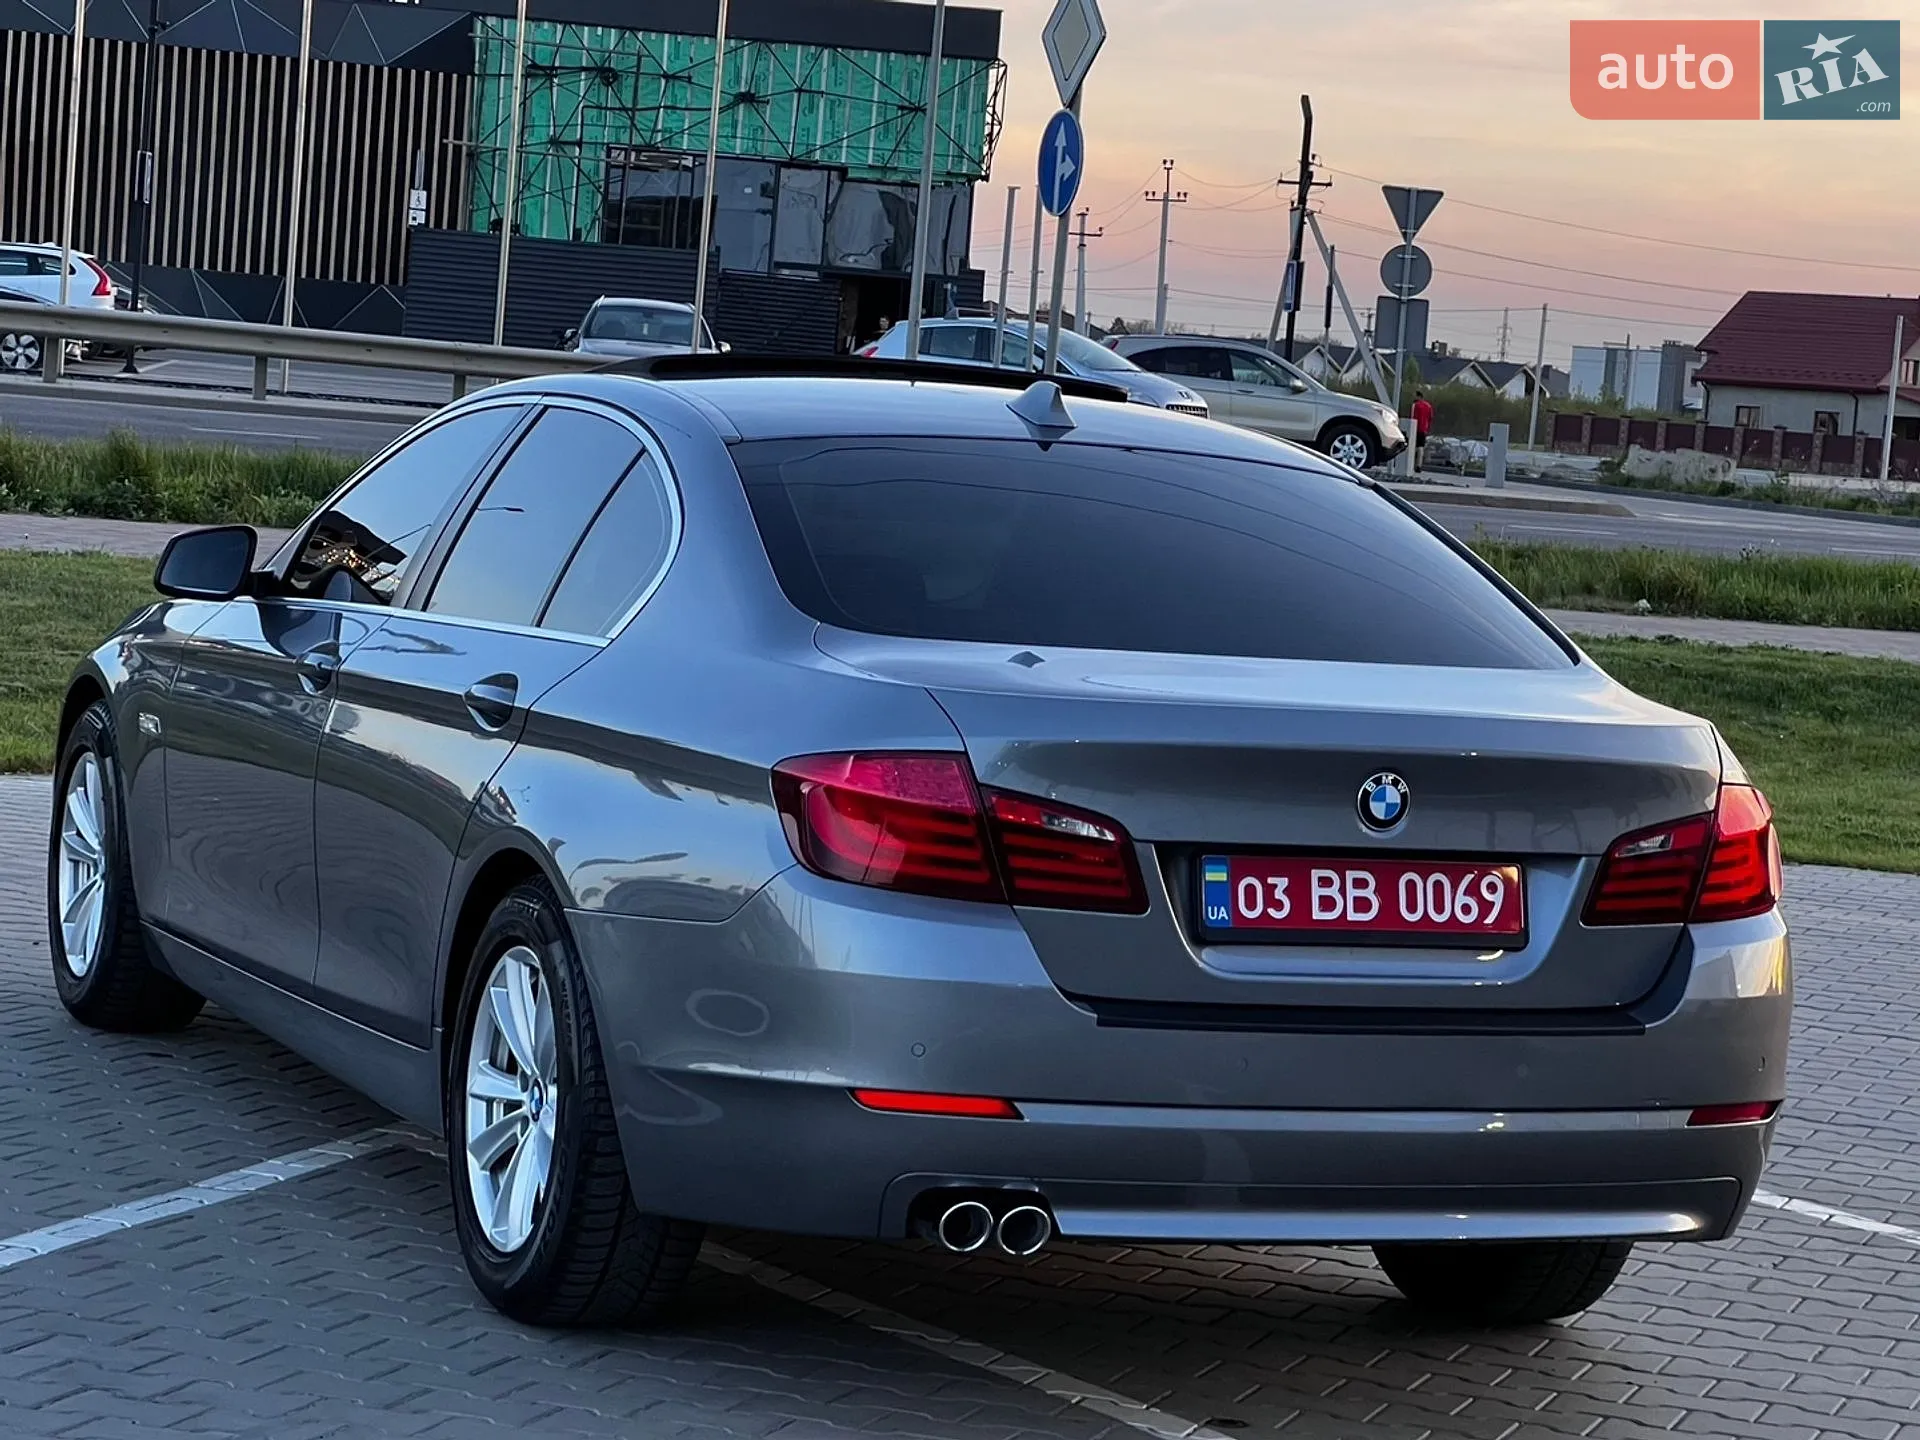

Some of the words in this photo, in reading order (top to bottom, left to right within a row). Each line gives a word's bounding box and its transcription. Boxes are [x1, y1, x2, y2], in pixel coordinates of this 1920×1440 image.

[1365, 774, 1407, 794] BMW
[1237, 876, 1291, 919] 03
[1310, 869, 1380, 921] BB
[1398, 871, 1505, 924] 0069
[1207, 906, 1229, 921] UA
